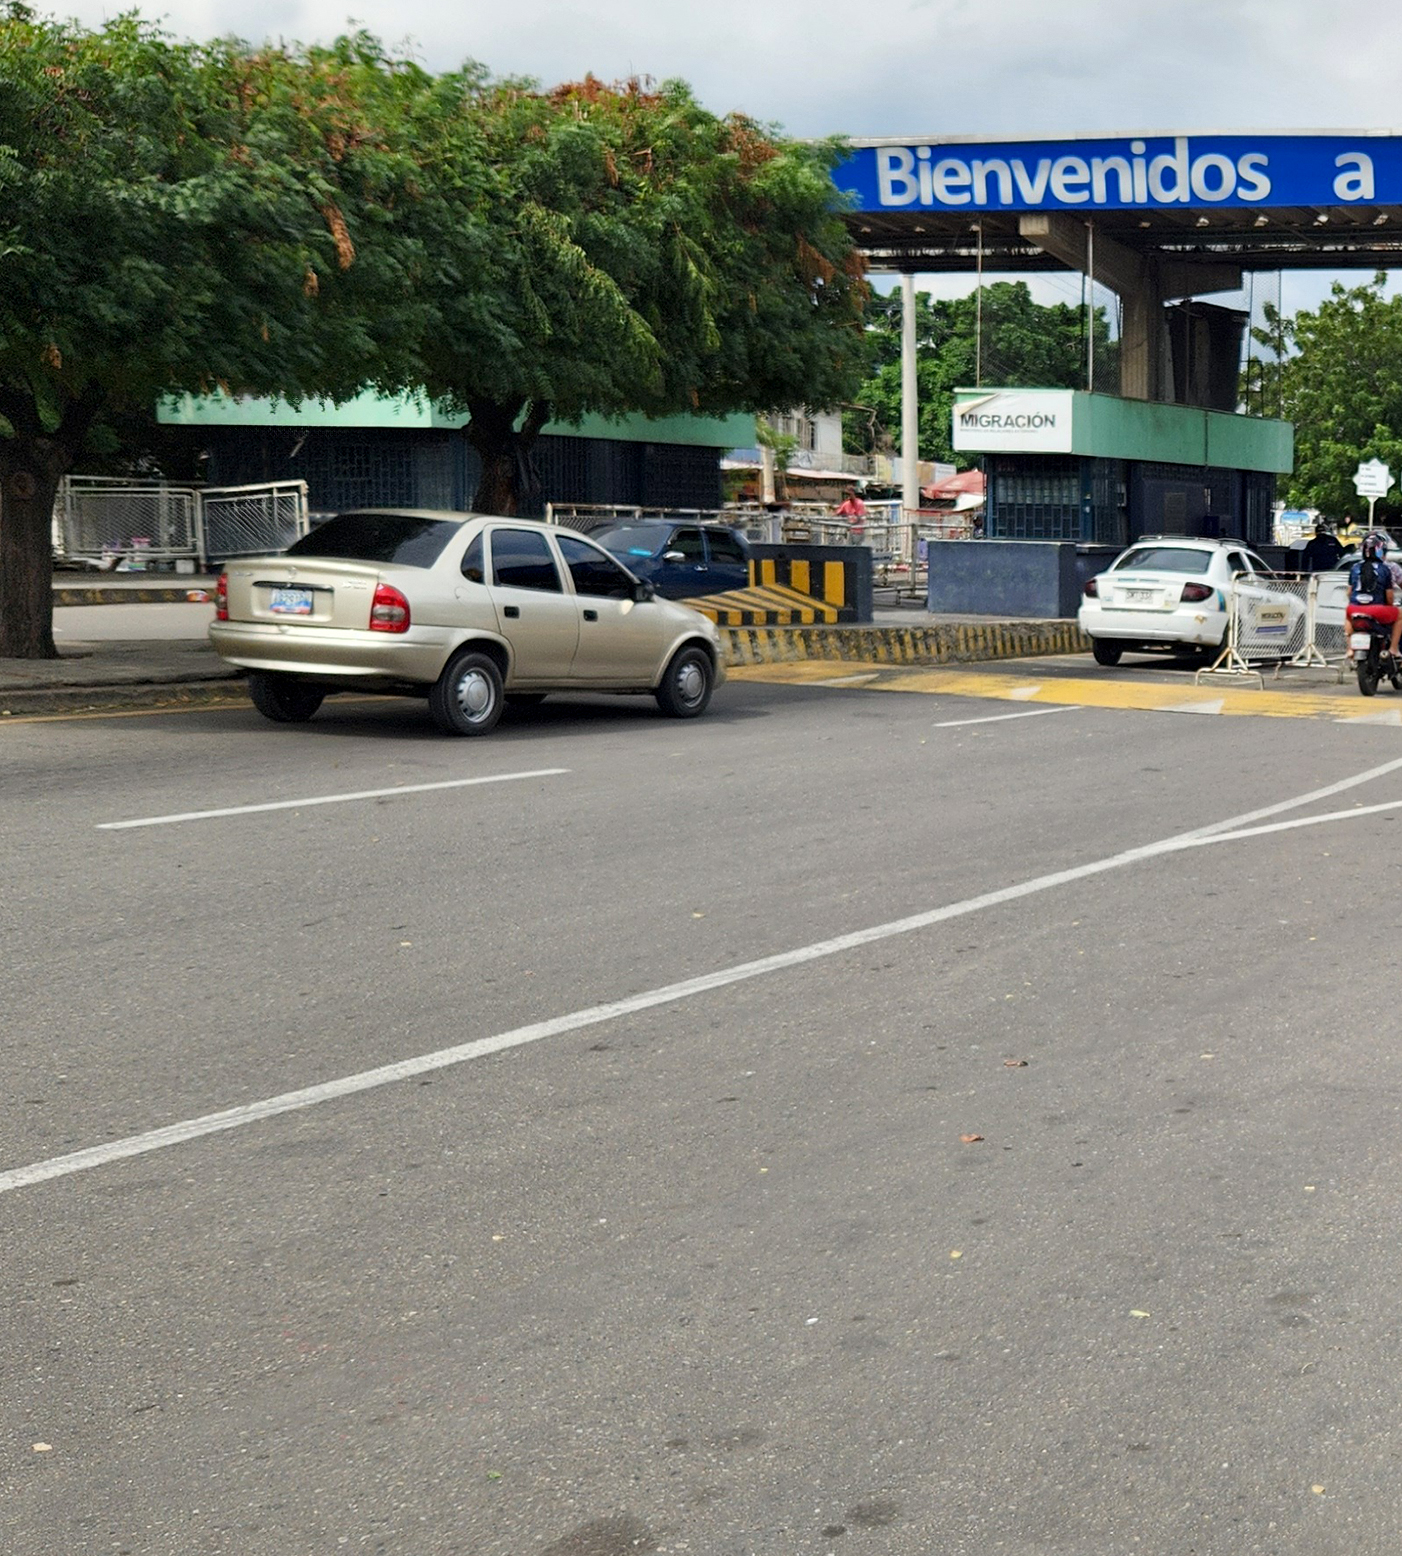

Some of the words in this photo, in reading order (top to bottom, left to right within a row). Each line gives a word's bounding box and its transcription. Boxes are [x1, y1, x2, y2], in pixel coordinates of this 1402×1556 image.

[876, 137, 1272, 206] Bienvenidos
[1333, 152, 1375, 200] a
[961, 412, 1056, 428] MIGRACIÓN
